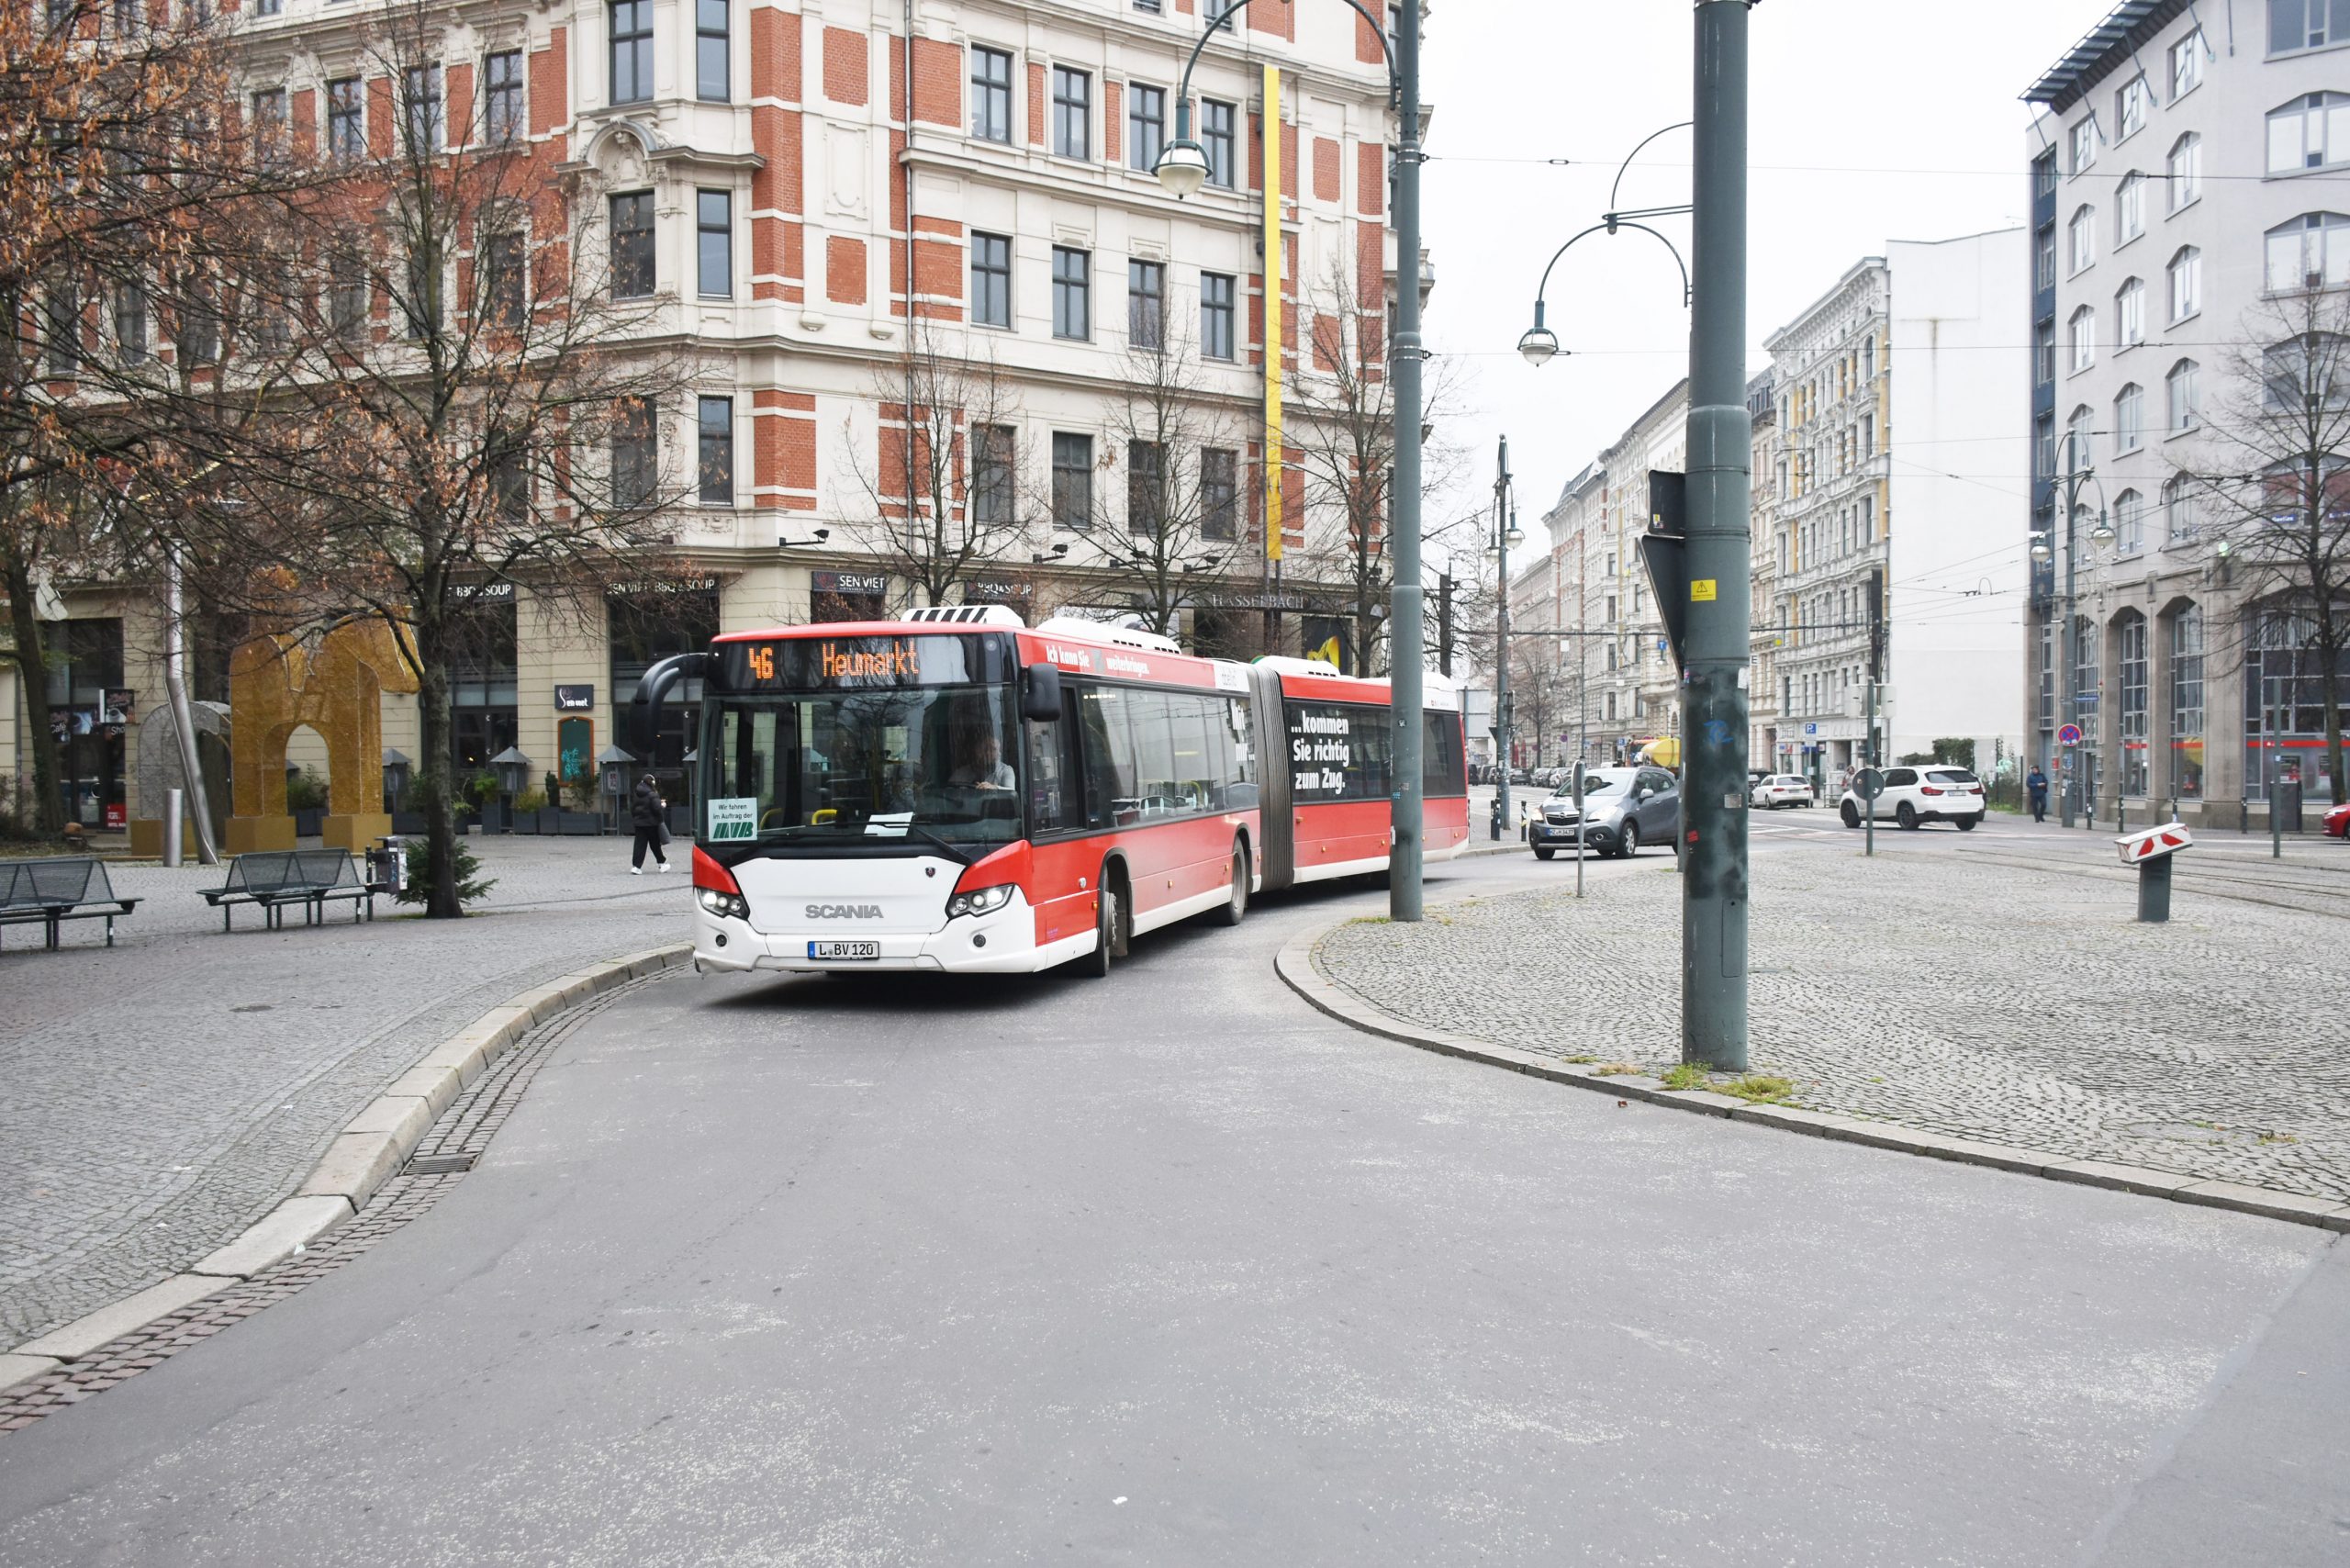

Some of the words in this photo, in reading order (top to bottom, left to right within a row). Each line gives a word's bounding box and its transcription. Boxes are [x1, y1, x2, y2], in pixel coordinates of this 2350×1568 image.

[839, 575, 860, 588] SEN
[862, 576, 885, 589] VIET
[485, 584, 511, 597] SOUP
[748, 647, 774, 679] 46
[822, 640, 920, 678] Heumarkt
[1046, 645, 1058, 663] Ich
[1058, 646, 1079, 666] kann
[1292, 737, 1312, 762] Sie
[1314, 737, 1350, 767] richtig
[1294, 772, 1320, 790] zum
[1321, 767, 1346, 795] Zug.
[721, 812, 743, 821] Auftrag
[805, 904, 885, 919] SCANIA
[819, 943, 827, 956] L
[834, 943, 849, 956] BV
[852, 943, 874, 956] 120
